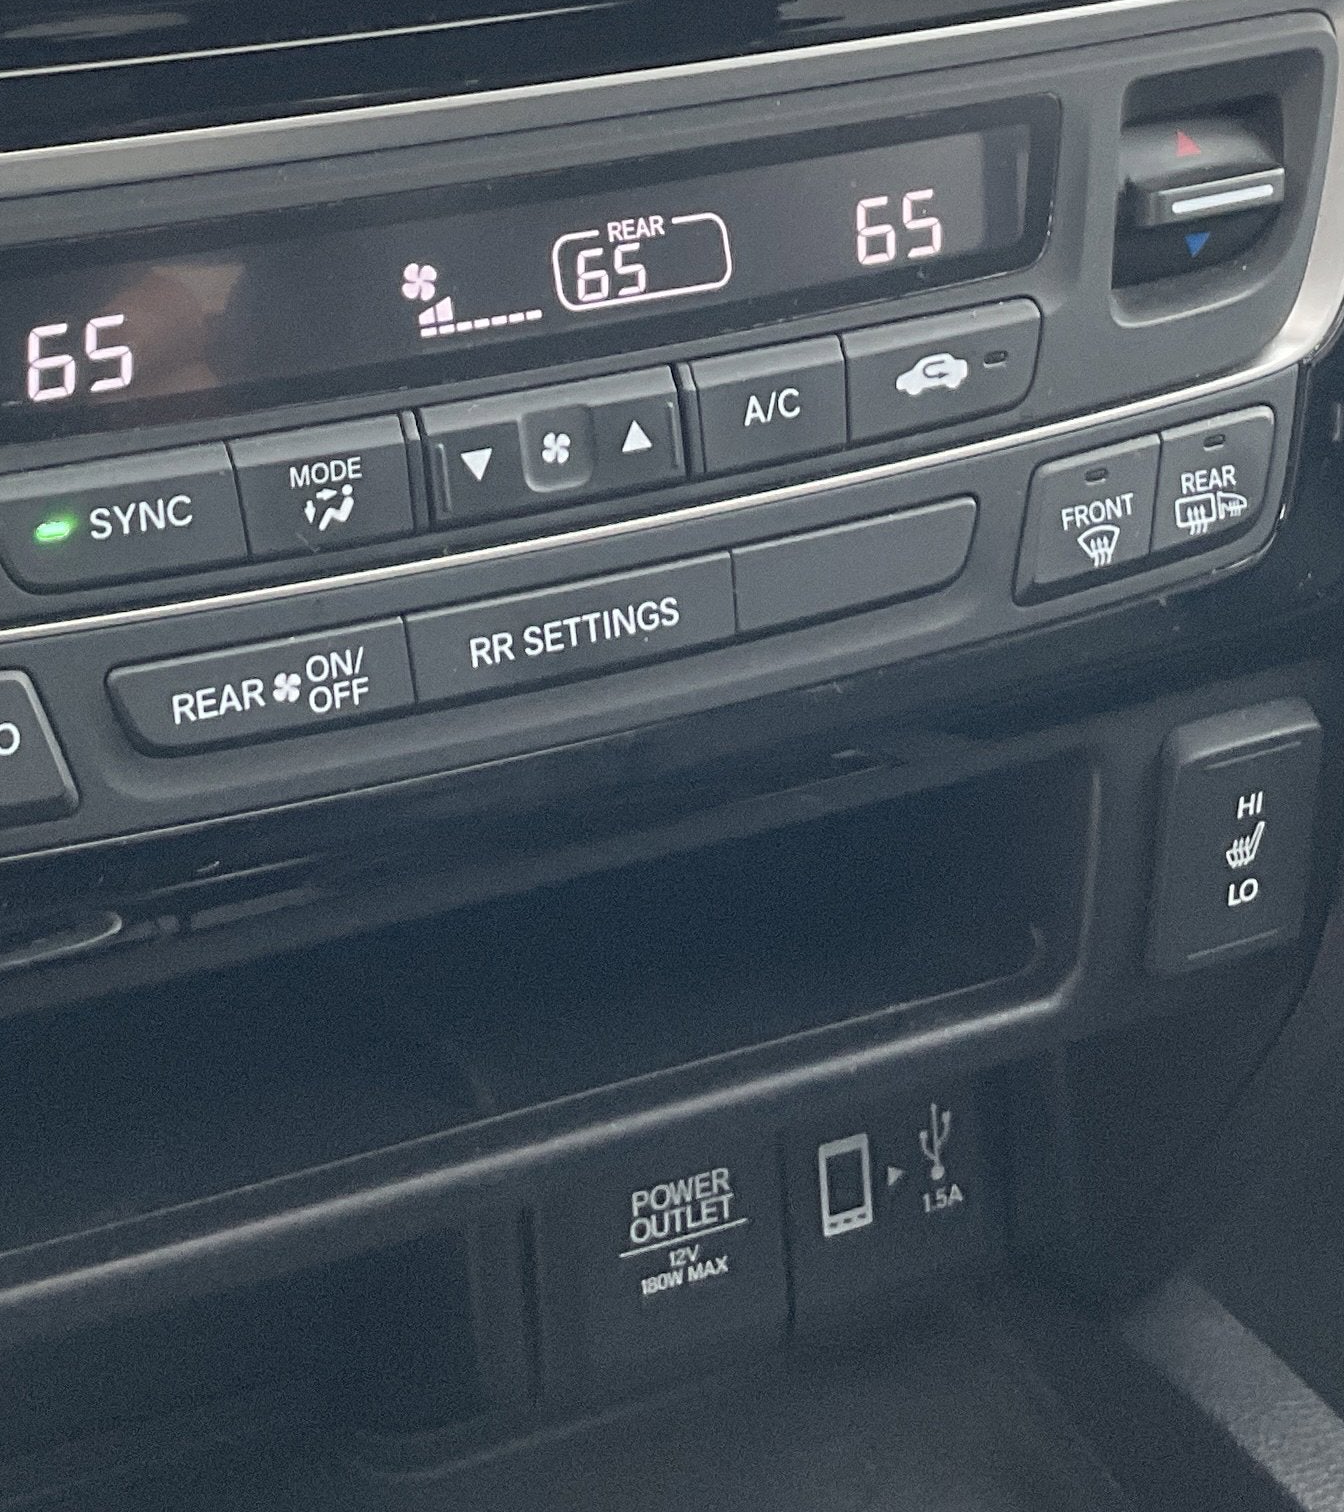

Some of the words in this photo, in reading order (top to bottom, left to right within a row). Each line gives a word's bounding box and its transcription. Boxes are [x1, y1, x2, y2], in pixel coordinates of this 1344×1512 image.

[607, 214, 665, 243] REAR
[856, 189, 942, 266] 65
[576, 241, 647, 303] 65
[27, 314, 133, 402] 65
[744, 388, 801, 427] A/C
[289, 456, 363, 489] MODE
[1181, 464, 1237, 494] REAR
[89, 494, 193, 540] SYNC
[1061, 493, 1134, 531] FRONT
[469, 630, 515, 669] RR
[523, 596, 680, 658] SETTINGS
[305, 646, 366, 684] ON/
[171, 677, 266, 725] REAR
[307, 677, 369, 714] OFF
[1237, 791, 1263, 819] HI
[1227, 878, 1259, 906] LO
[631, 1167, 730, 1216] POWER
[923, 1183, 963, 1213] 1.5A
[630, 1192, 734, 1245] OUTLET
[669, 1244, 699, 1267] 12V
[687, 1255, 729, 1282] MAX
